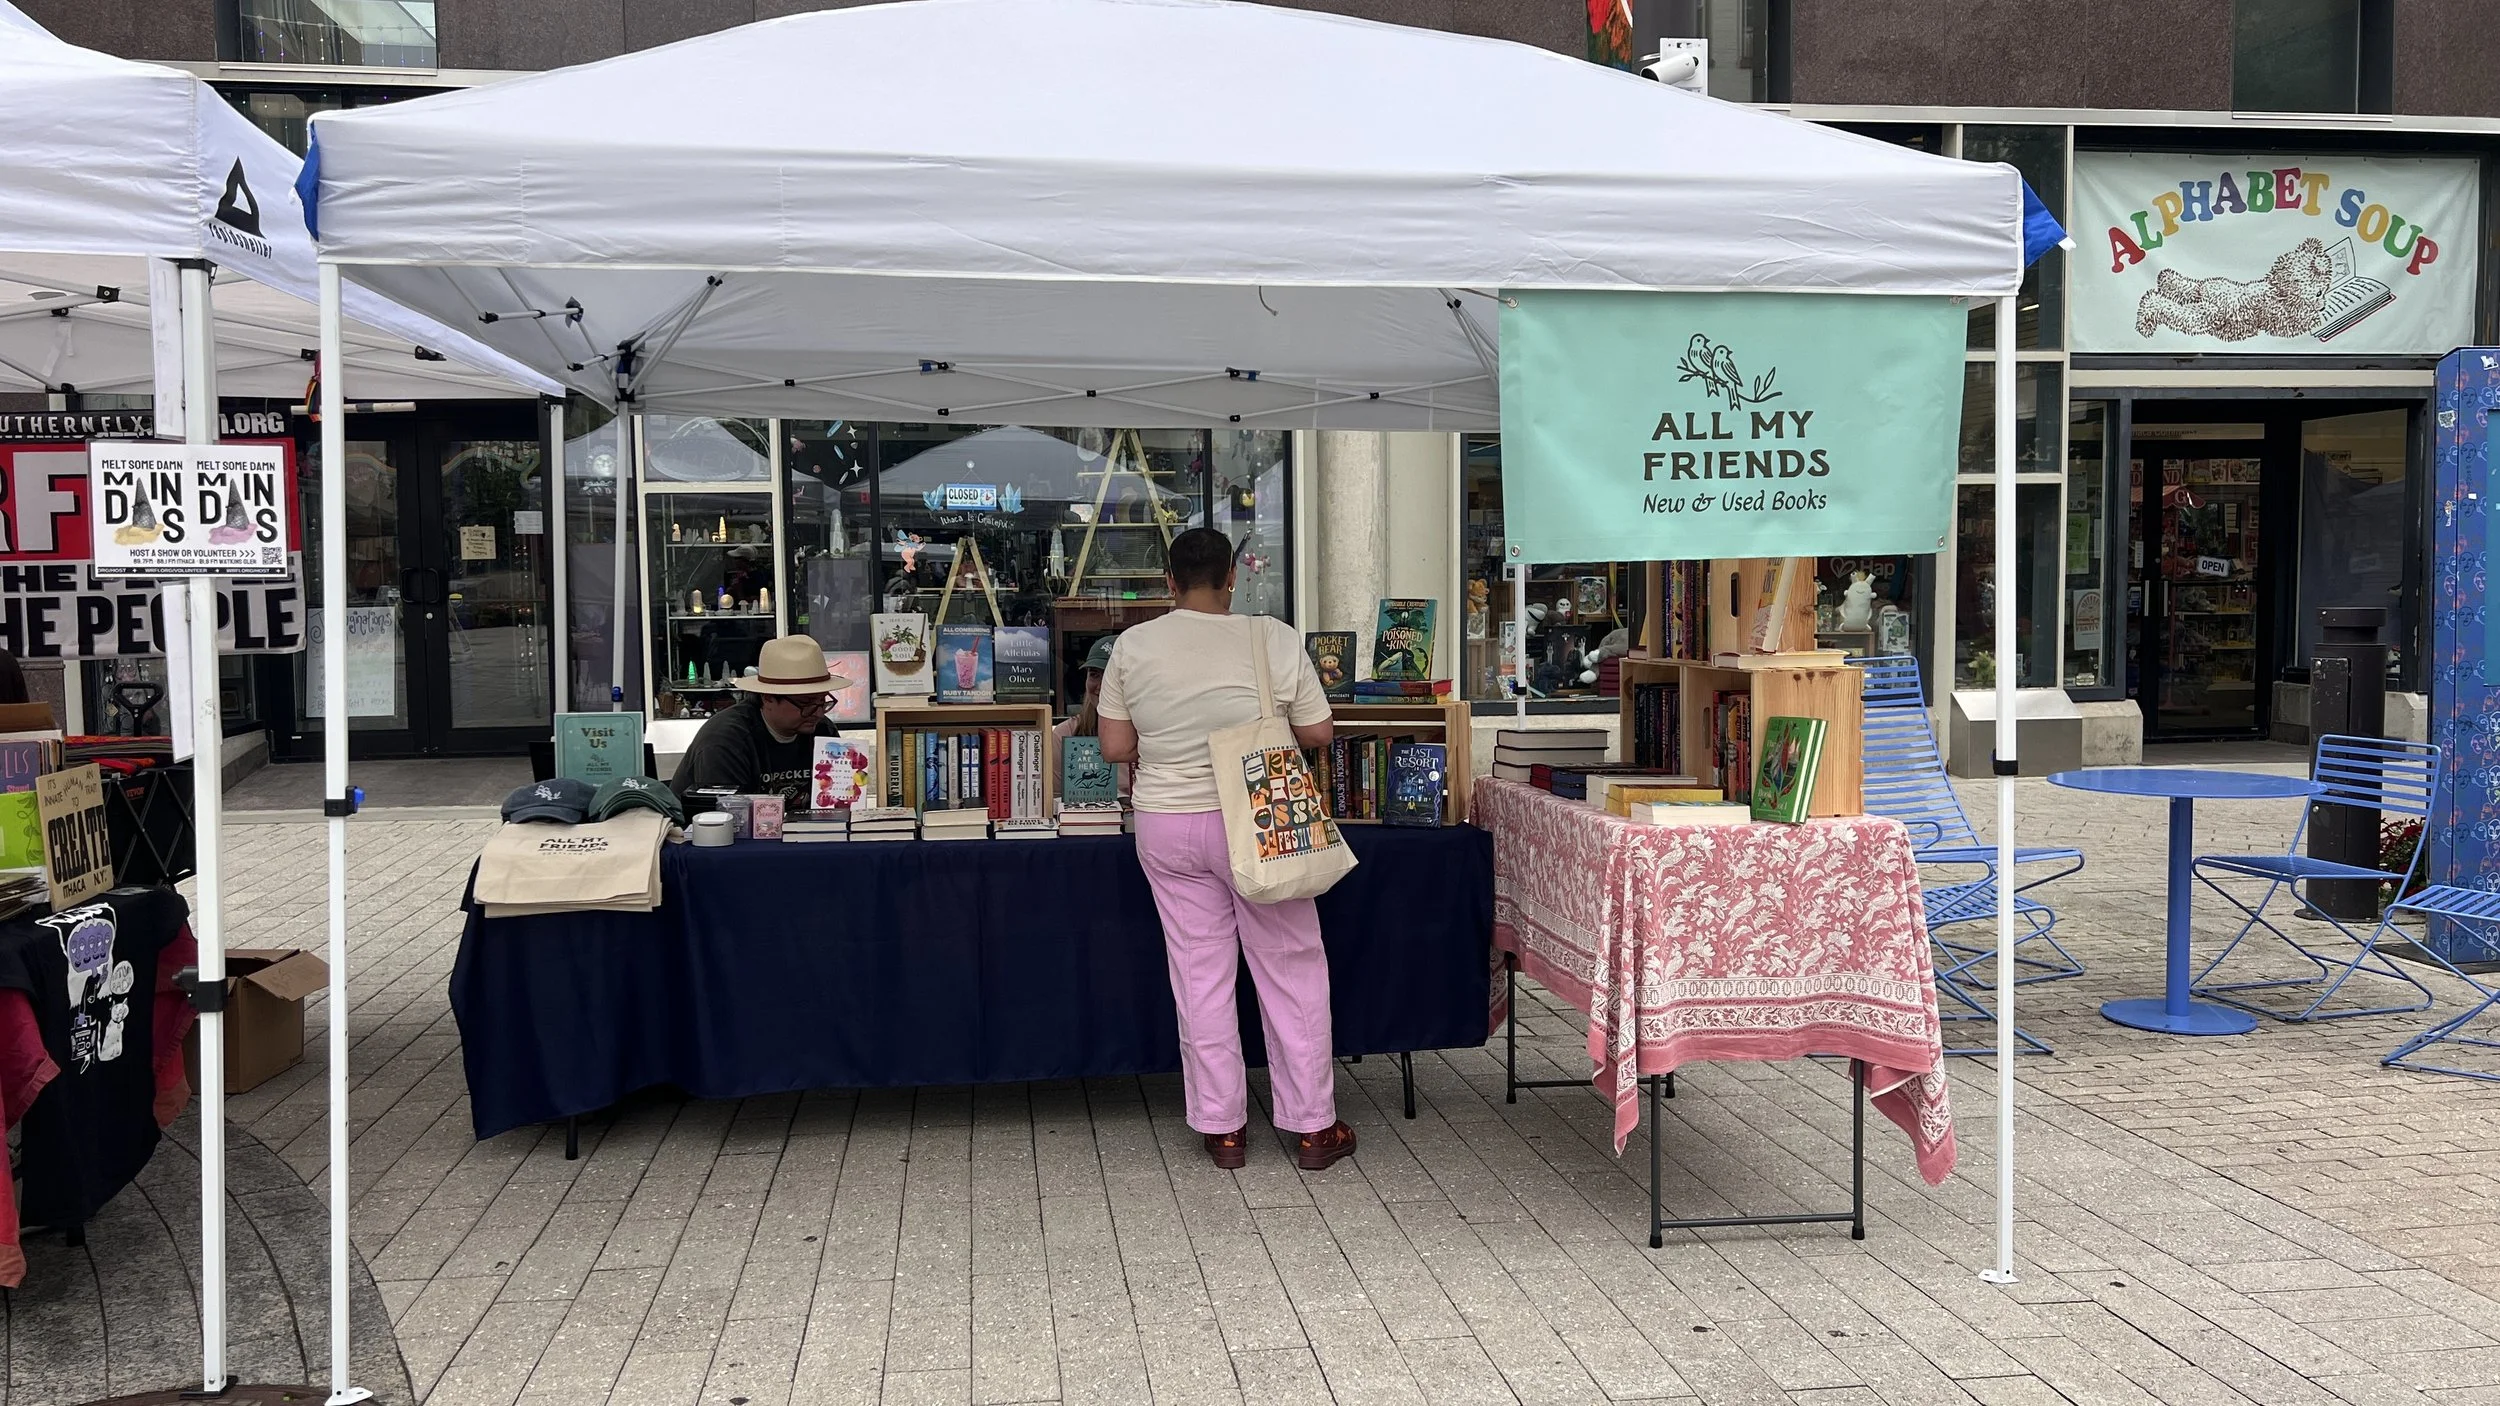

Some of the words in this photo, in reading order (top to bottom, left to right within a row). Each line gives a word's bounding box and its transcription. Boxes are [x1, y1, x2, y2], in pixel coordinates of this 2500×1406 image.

[2107, 166, 2330, 274] ALPHABET
[2335, 188, 2440, 276] SOUP
[1651, 411, 1734, 441] ALL
[1750, 410, 1815, 440] MY
[102, 460, 127, 470] MELT
[128, 460, 155, 470] SOME
[156, 460, 183, 471] DAMN
[196, 461, 221, 471] MELT
[222, 461, 248, 471] SOME
[249, 462, 276, 471] DAMN
[1642, 449, 1831, 481] FRIENDS
[948, 488, 979, 500] CLOSED
[1642, 493, 1687, 515] New
[1691, 492, 1717, 512] &
[1722, 488, 1766, 512] Used
[1771, 487, 1828, 512] Books
[129, 550, 150, 558] HOST
[151, 550, 156, 558] A
[158, 550, 180, 558] SHOW
[181, 550, 192, 558] OR
[193, 550, 237, 558] VOLUNTEER
[2201, 559, 2225, 573] OPEN
[77, 587, 301, 656] PELE
[1314, 636, 1349, 648] POCKET
[1382, 630, 1423, 642] POISONED
[1010, 639, 1033, 647] Little
[1387, 641, 1416, 650] KING
[1011, 665, 1033, 675] Mary
[1008, 675, 1036, 683] Oliver
[581, 727, 615, 737] Visit
[589, 738, 607, 749] Us
[1017, 735, 1026, 772] Challenger
[1033, 734, 1041, 772] Challenger
[1410, 747, 1433, 757] LAST
[1078, 762, 1100, 770] HERE
[47, 804, 111, 885] CREATE
[540, 841, 609, 849] FRIENDS
[1277, 826, 1326, 852] FESTIVAL
[62, 875, 87, 900] ITHACA
